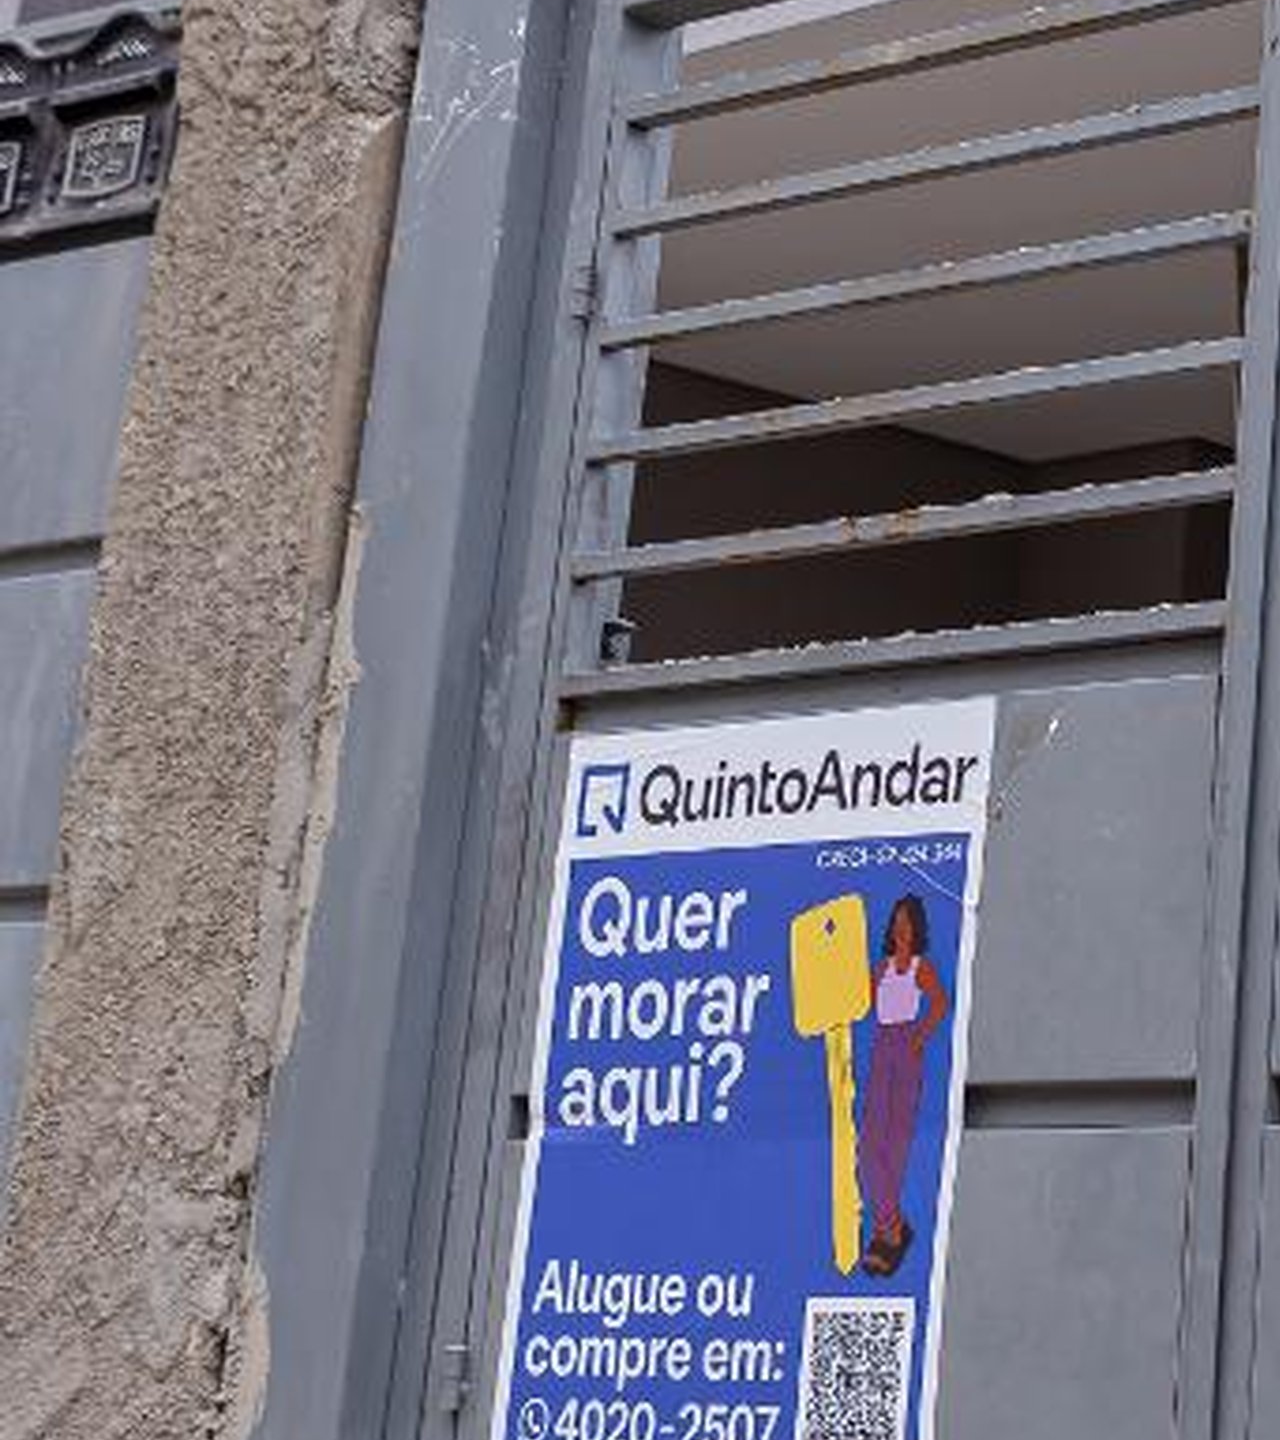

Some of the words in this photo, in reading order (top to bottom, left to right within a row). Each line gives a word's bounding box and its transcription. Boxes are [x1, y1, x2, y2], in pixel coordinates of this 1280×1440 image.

[640, 742, 977, 827] QuintoAndar
[579, 876, 748, 958] Quer
[567, 969, 770, 1041] morar
[558, 1041, 745, 1145] aqui?
[532, 1259, 687, 1328] Alugue
[699, 1272, 754, 1318] ou
[524, 1330, 692, 1391] compre
[703, 1338, 786, 1382] em:
